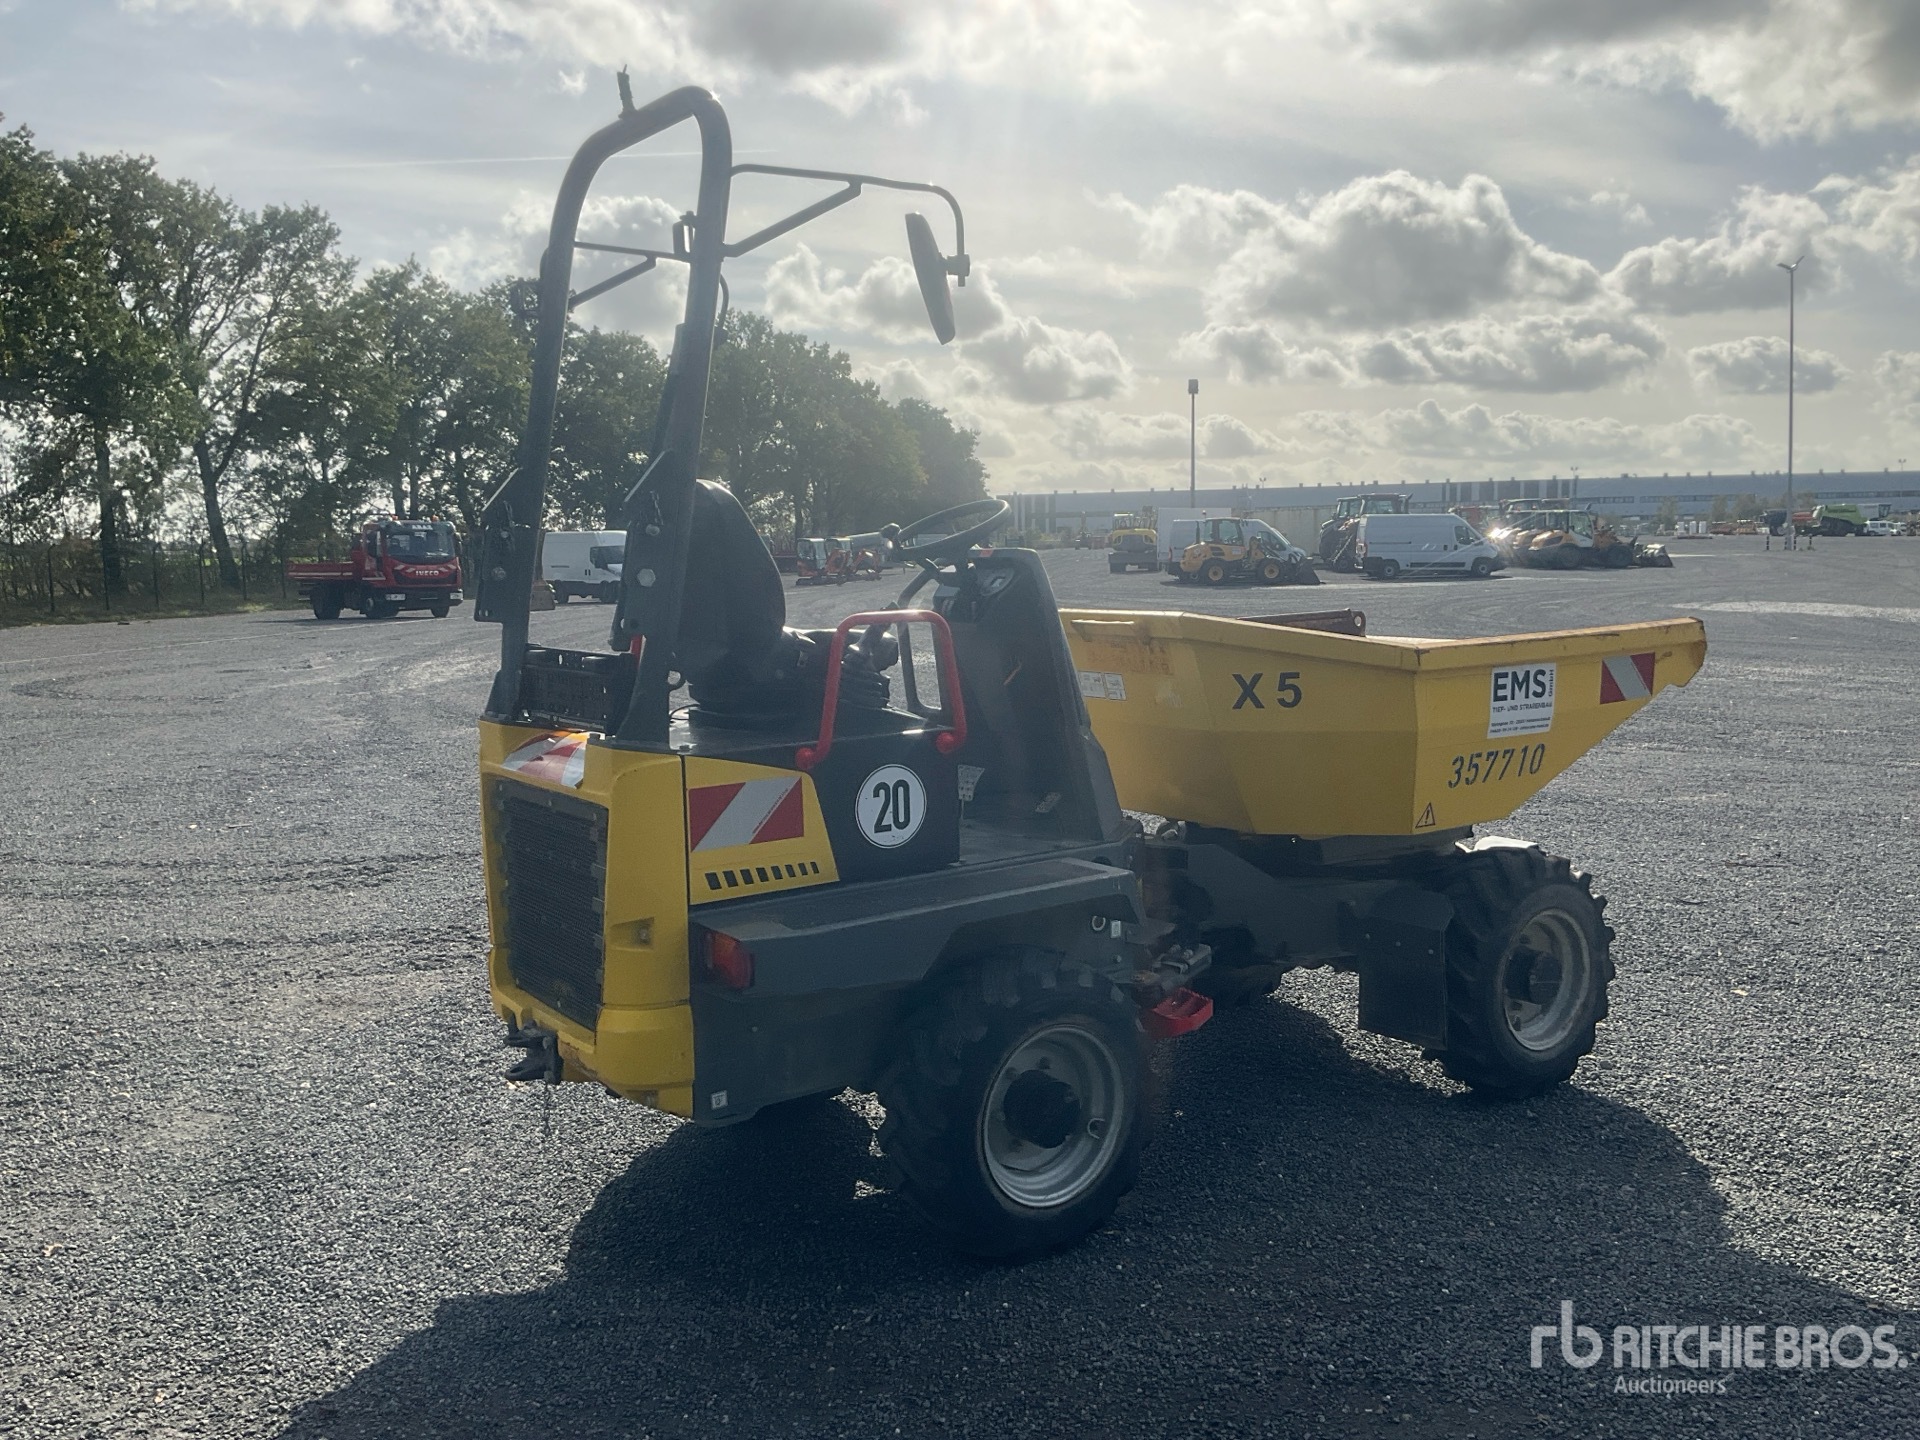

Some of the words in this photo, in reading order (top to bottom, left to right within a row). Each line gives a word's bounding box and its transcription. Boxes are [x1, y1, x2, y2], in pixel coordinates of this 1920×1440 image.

[1231, 672, 1265, 709] X
[1276, 672, 1302, 708] 5
[1493, 669, 1546, 702] EMS
[1448, 743, 1545, 789] 357710
[873, 779, 911, 834] 20
